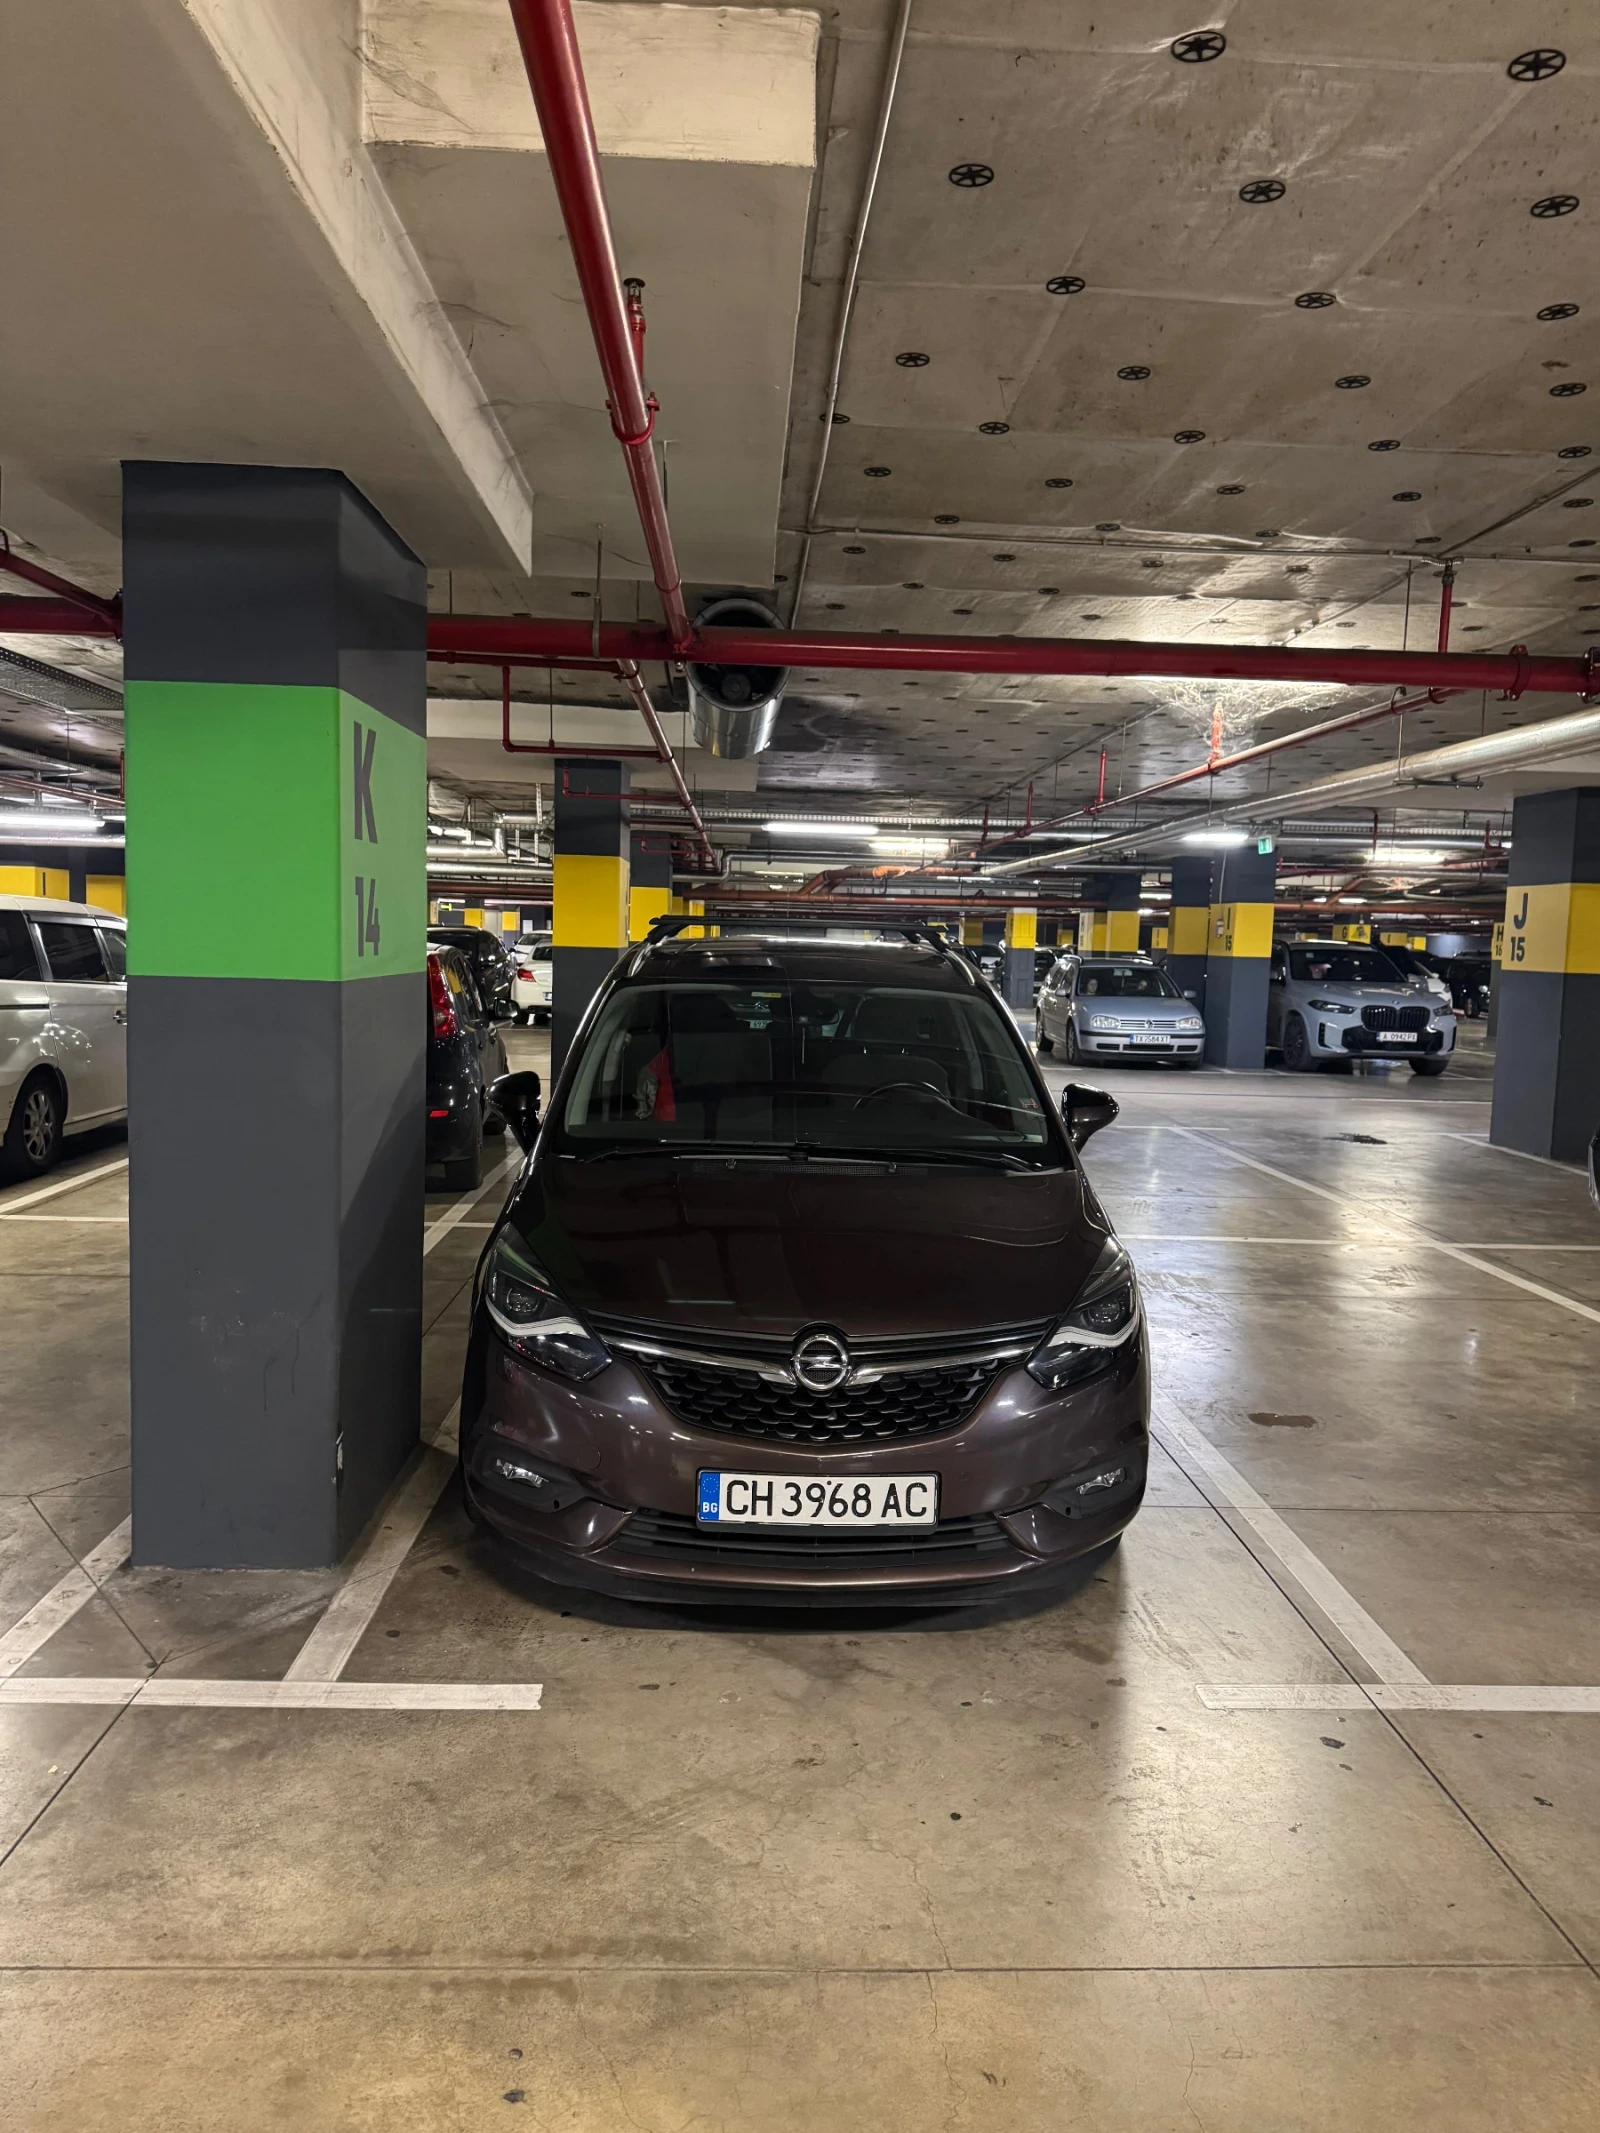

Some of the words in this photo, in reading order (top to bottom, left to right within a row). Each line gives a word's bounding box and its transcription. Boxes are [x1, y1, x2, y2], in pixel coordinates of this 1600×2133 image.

[353, 721, 378, 844] K
[355, 876, 380, 957] 14
[1227, 907, 1231, 930] I
[1513, 893, 1529, 930] J
[1225, 935, 1232, 951] 15
[1496, 925, 1504, 942] H
[1510, 936, 1526, 962] 15
[702, 1502, 718, 1513] BG
[726, 1480, 774, 1516] CH
[781, 1482, 872, 1518] 3968
[881, 1482, 928, 1518] AC
